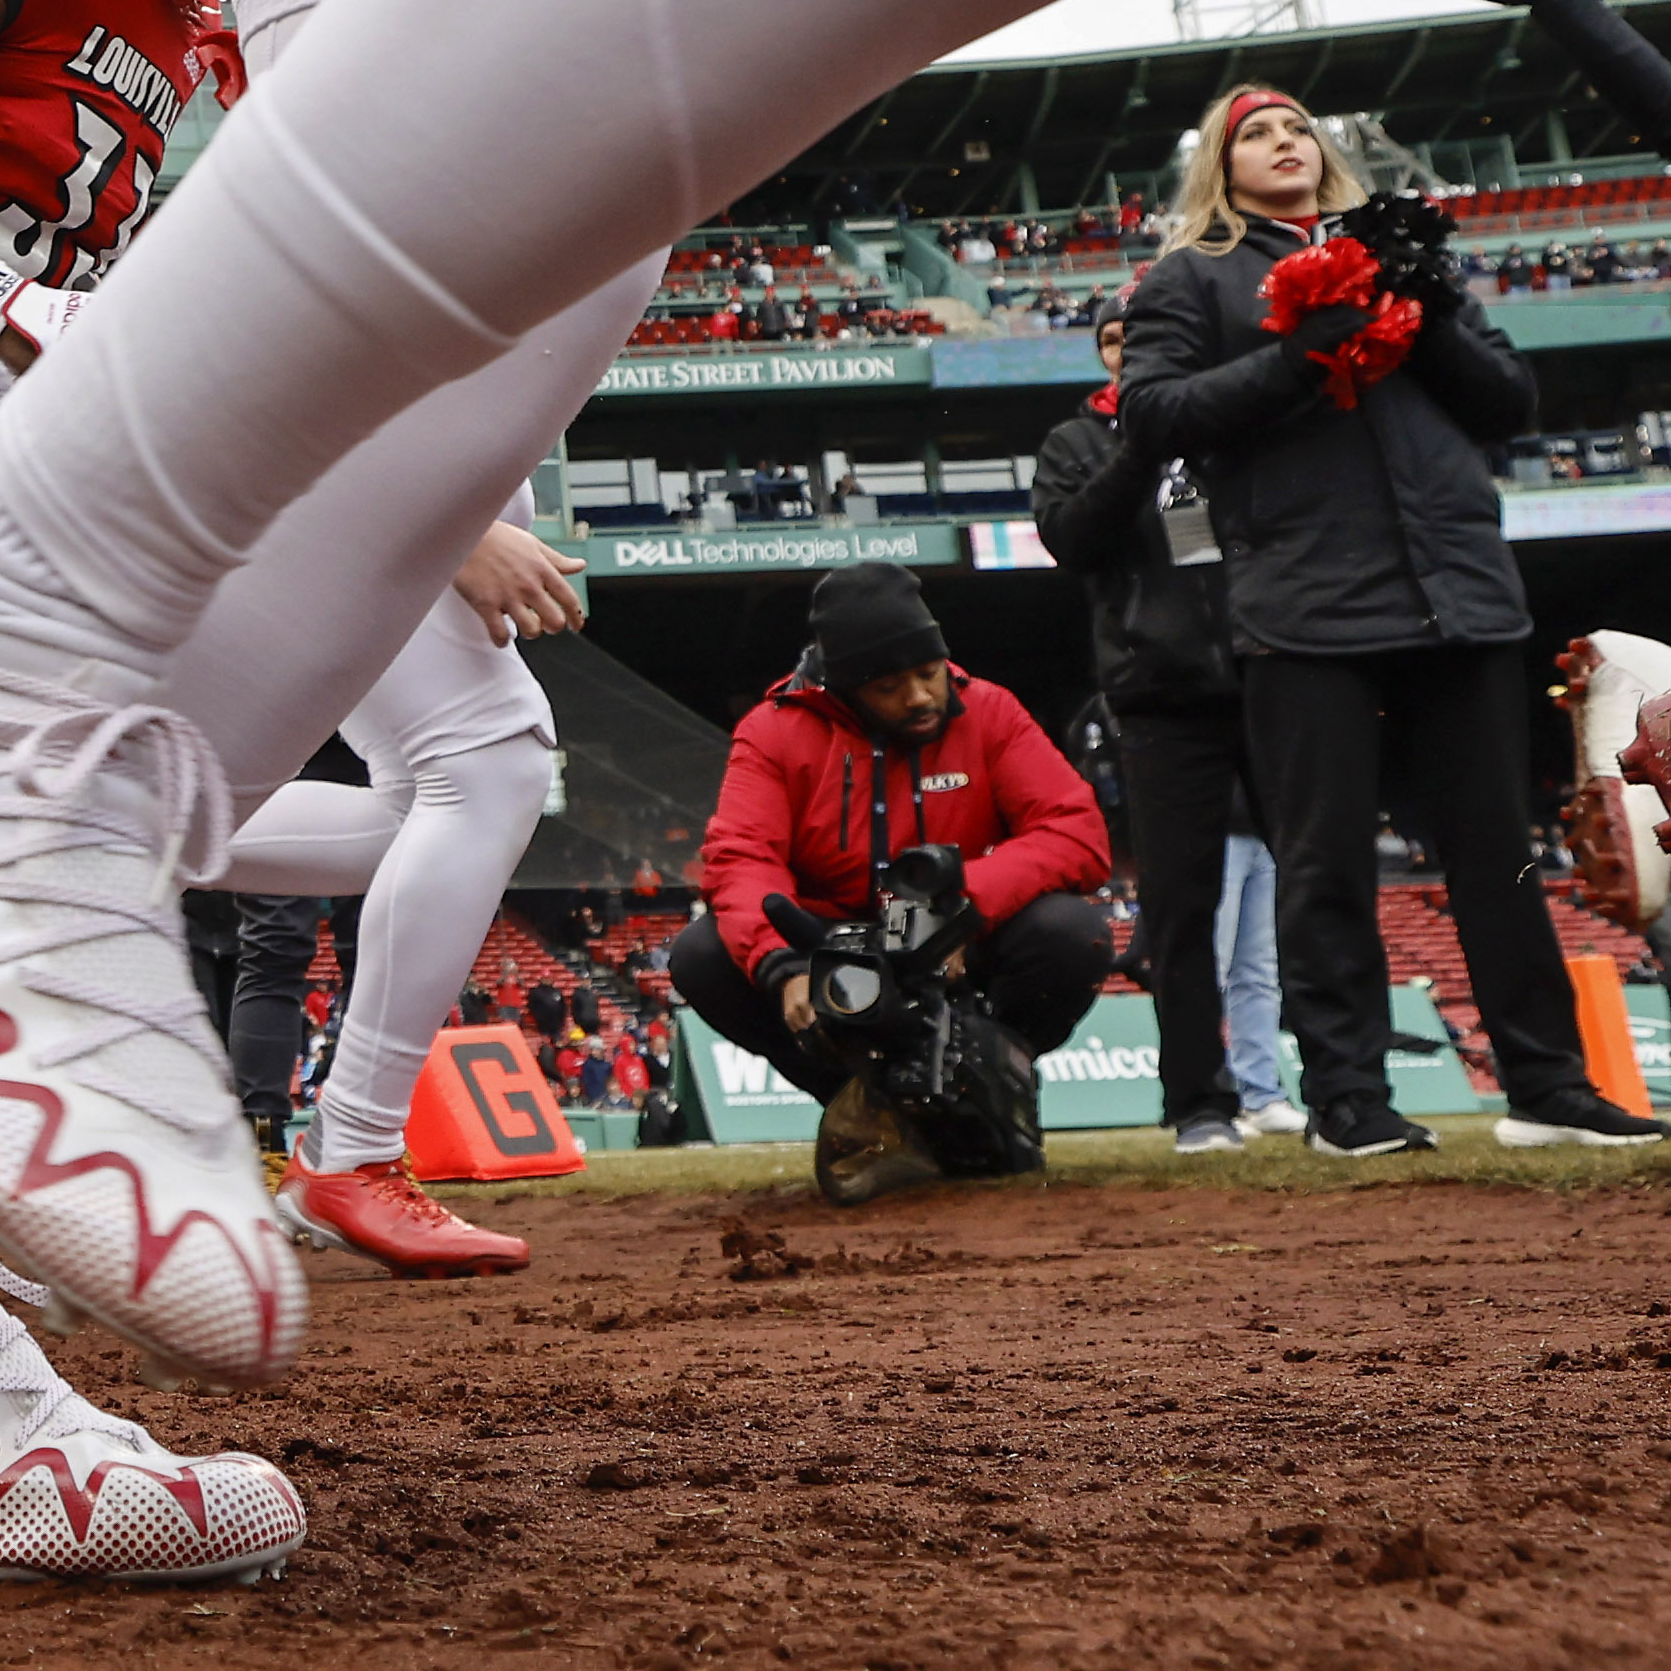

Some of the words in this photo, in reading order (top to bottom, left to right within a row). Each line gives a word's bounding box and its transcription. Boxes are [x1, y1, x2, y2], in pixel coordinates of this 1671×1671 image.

[670, 360, 763, 388] STREET
[771, 356, 896, 381] PAVILION
[613, 540, 692, 567] DELL
[690, 537, 849, 566] Technologies
[855, 533, 918, 557] Level
[451, 1042, 551, 1157] G
